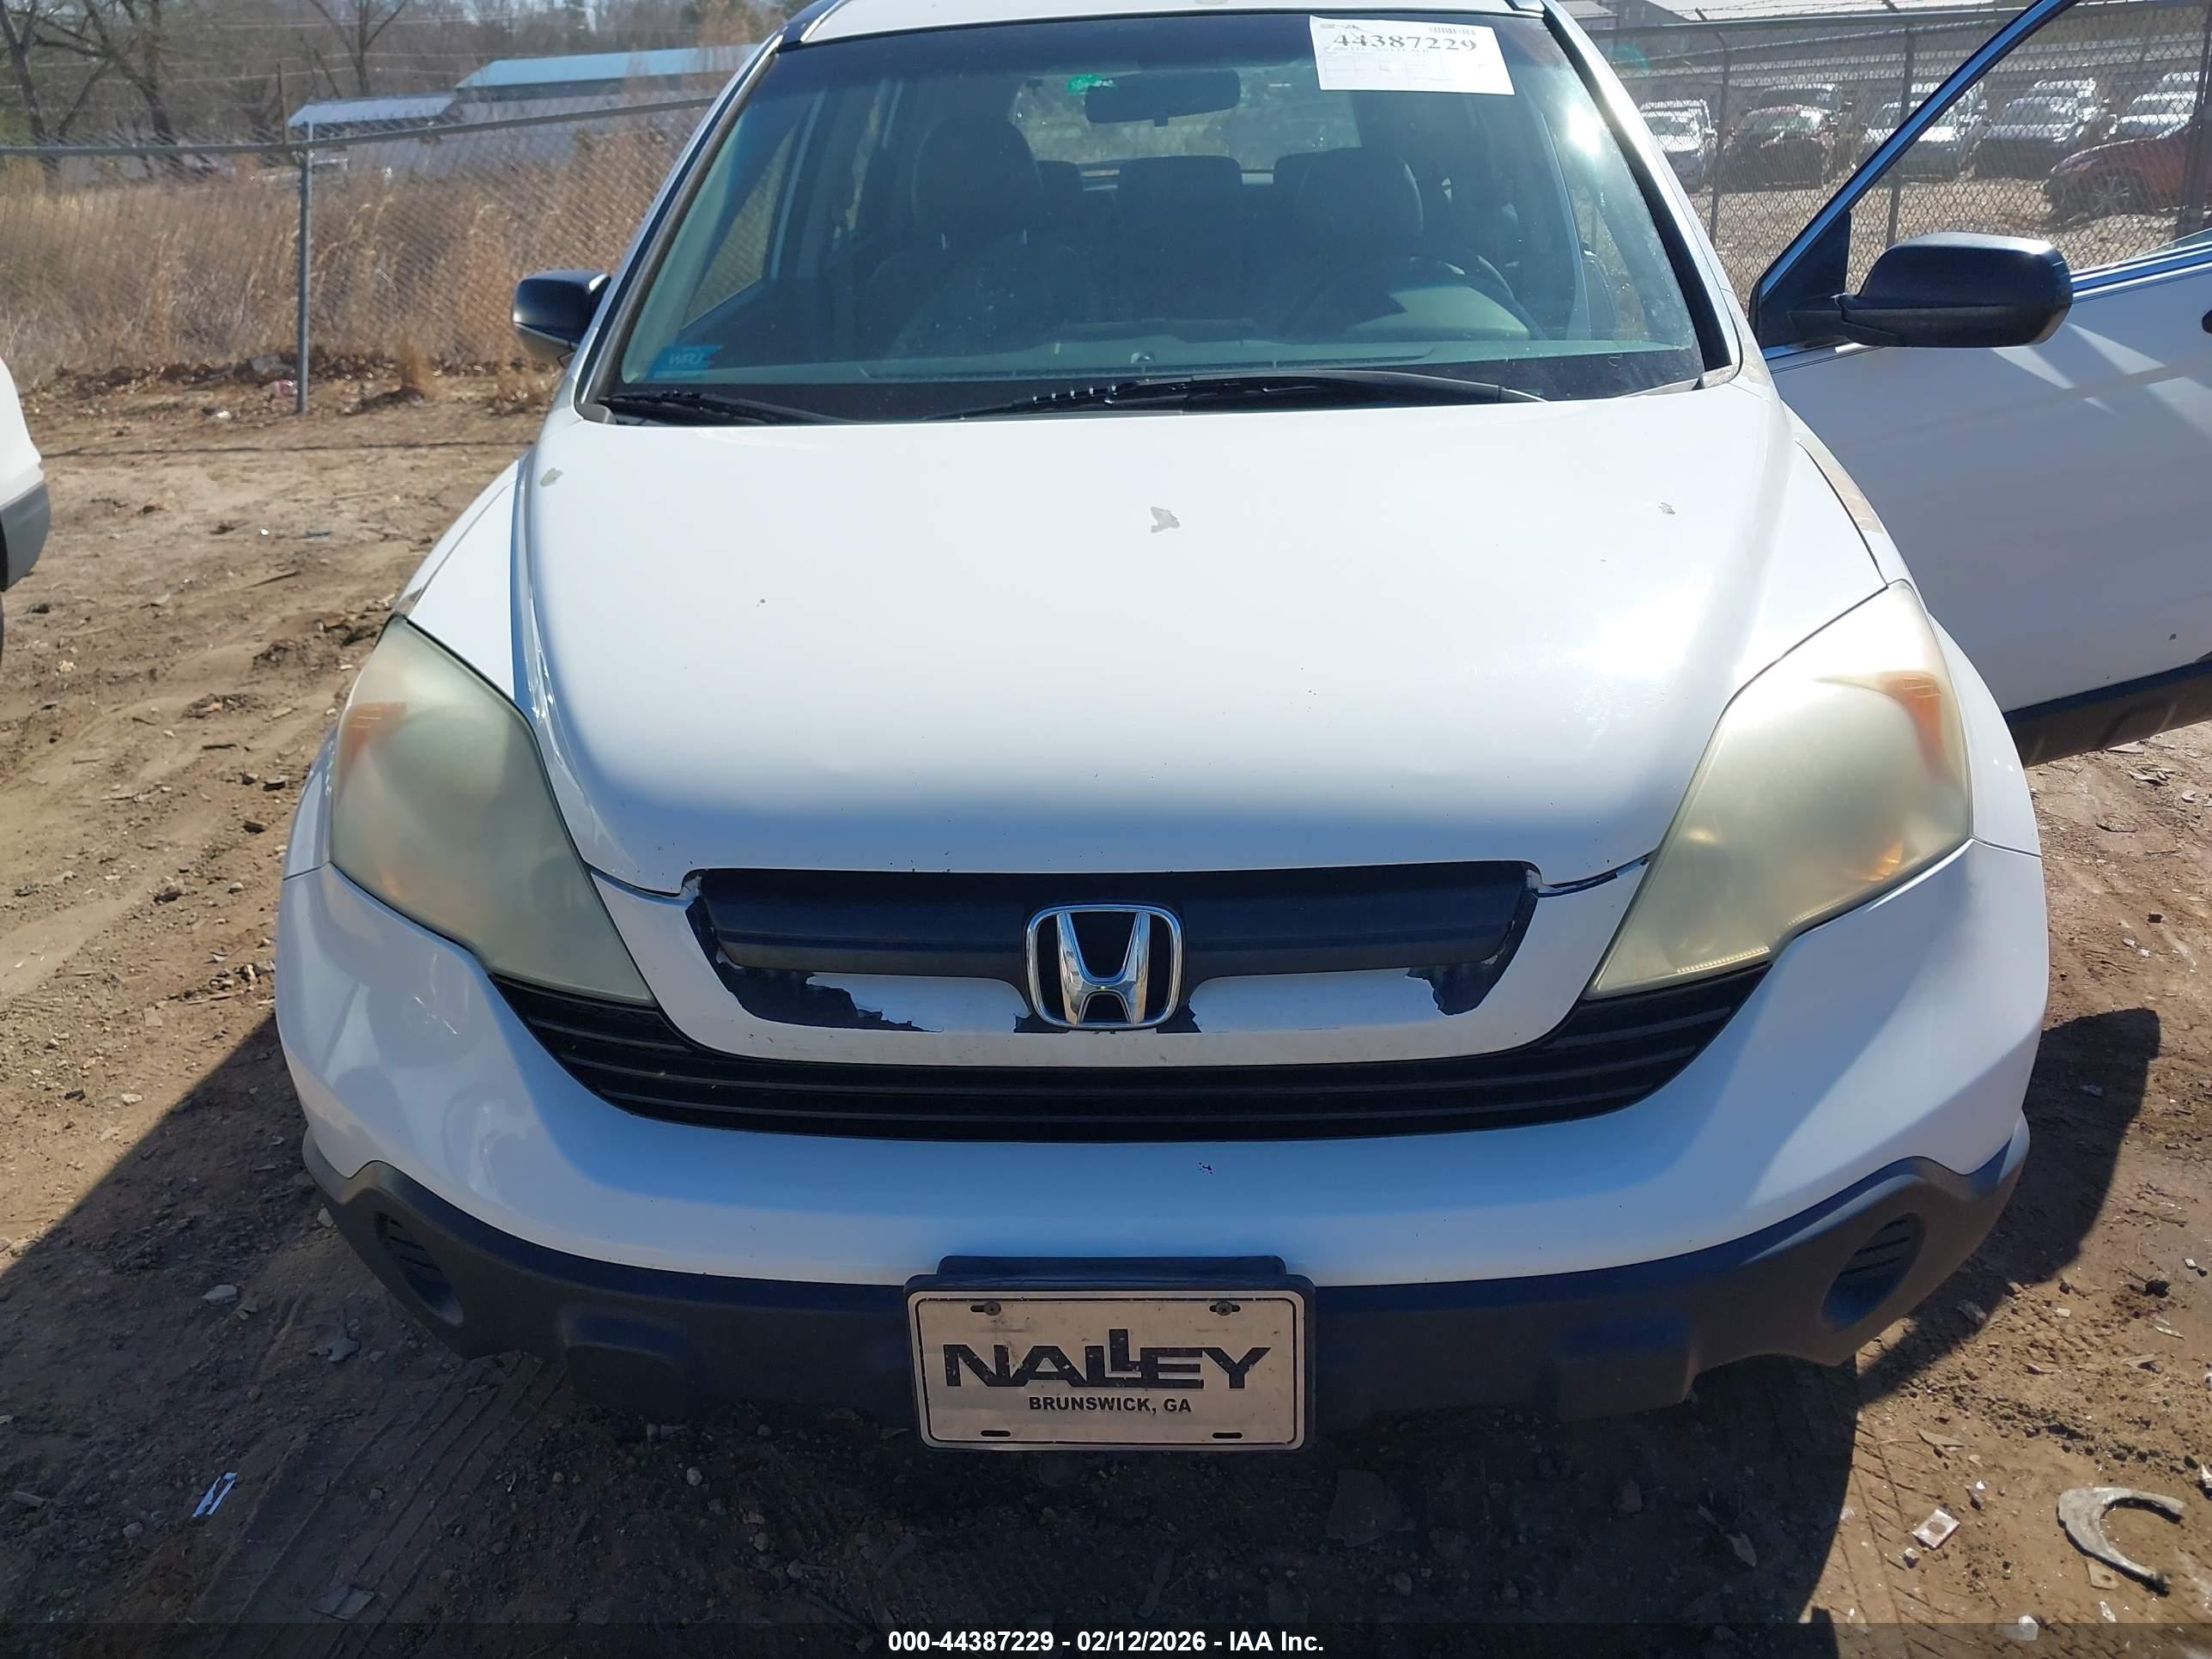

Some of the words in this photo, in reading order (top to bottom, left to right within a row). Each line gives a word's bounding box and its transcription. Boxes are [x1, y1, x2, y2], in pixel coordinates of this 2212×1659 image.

[1333, 34, 1477, 52] 44387229
[943, 1328, 1272, 1389] NALLEY
[1030, 1396, 1158, 1415] BRUNSWICK,
[1163, 1398, 1192, 1413] GA
